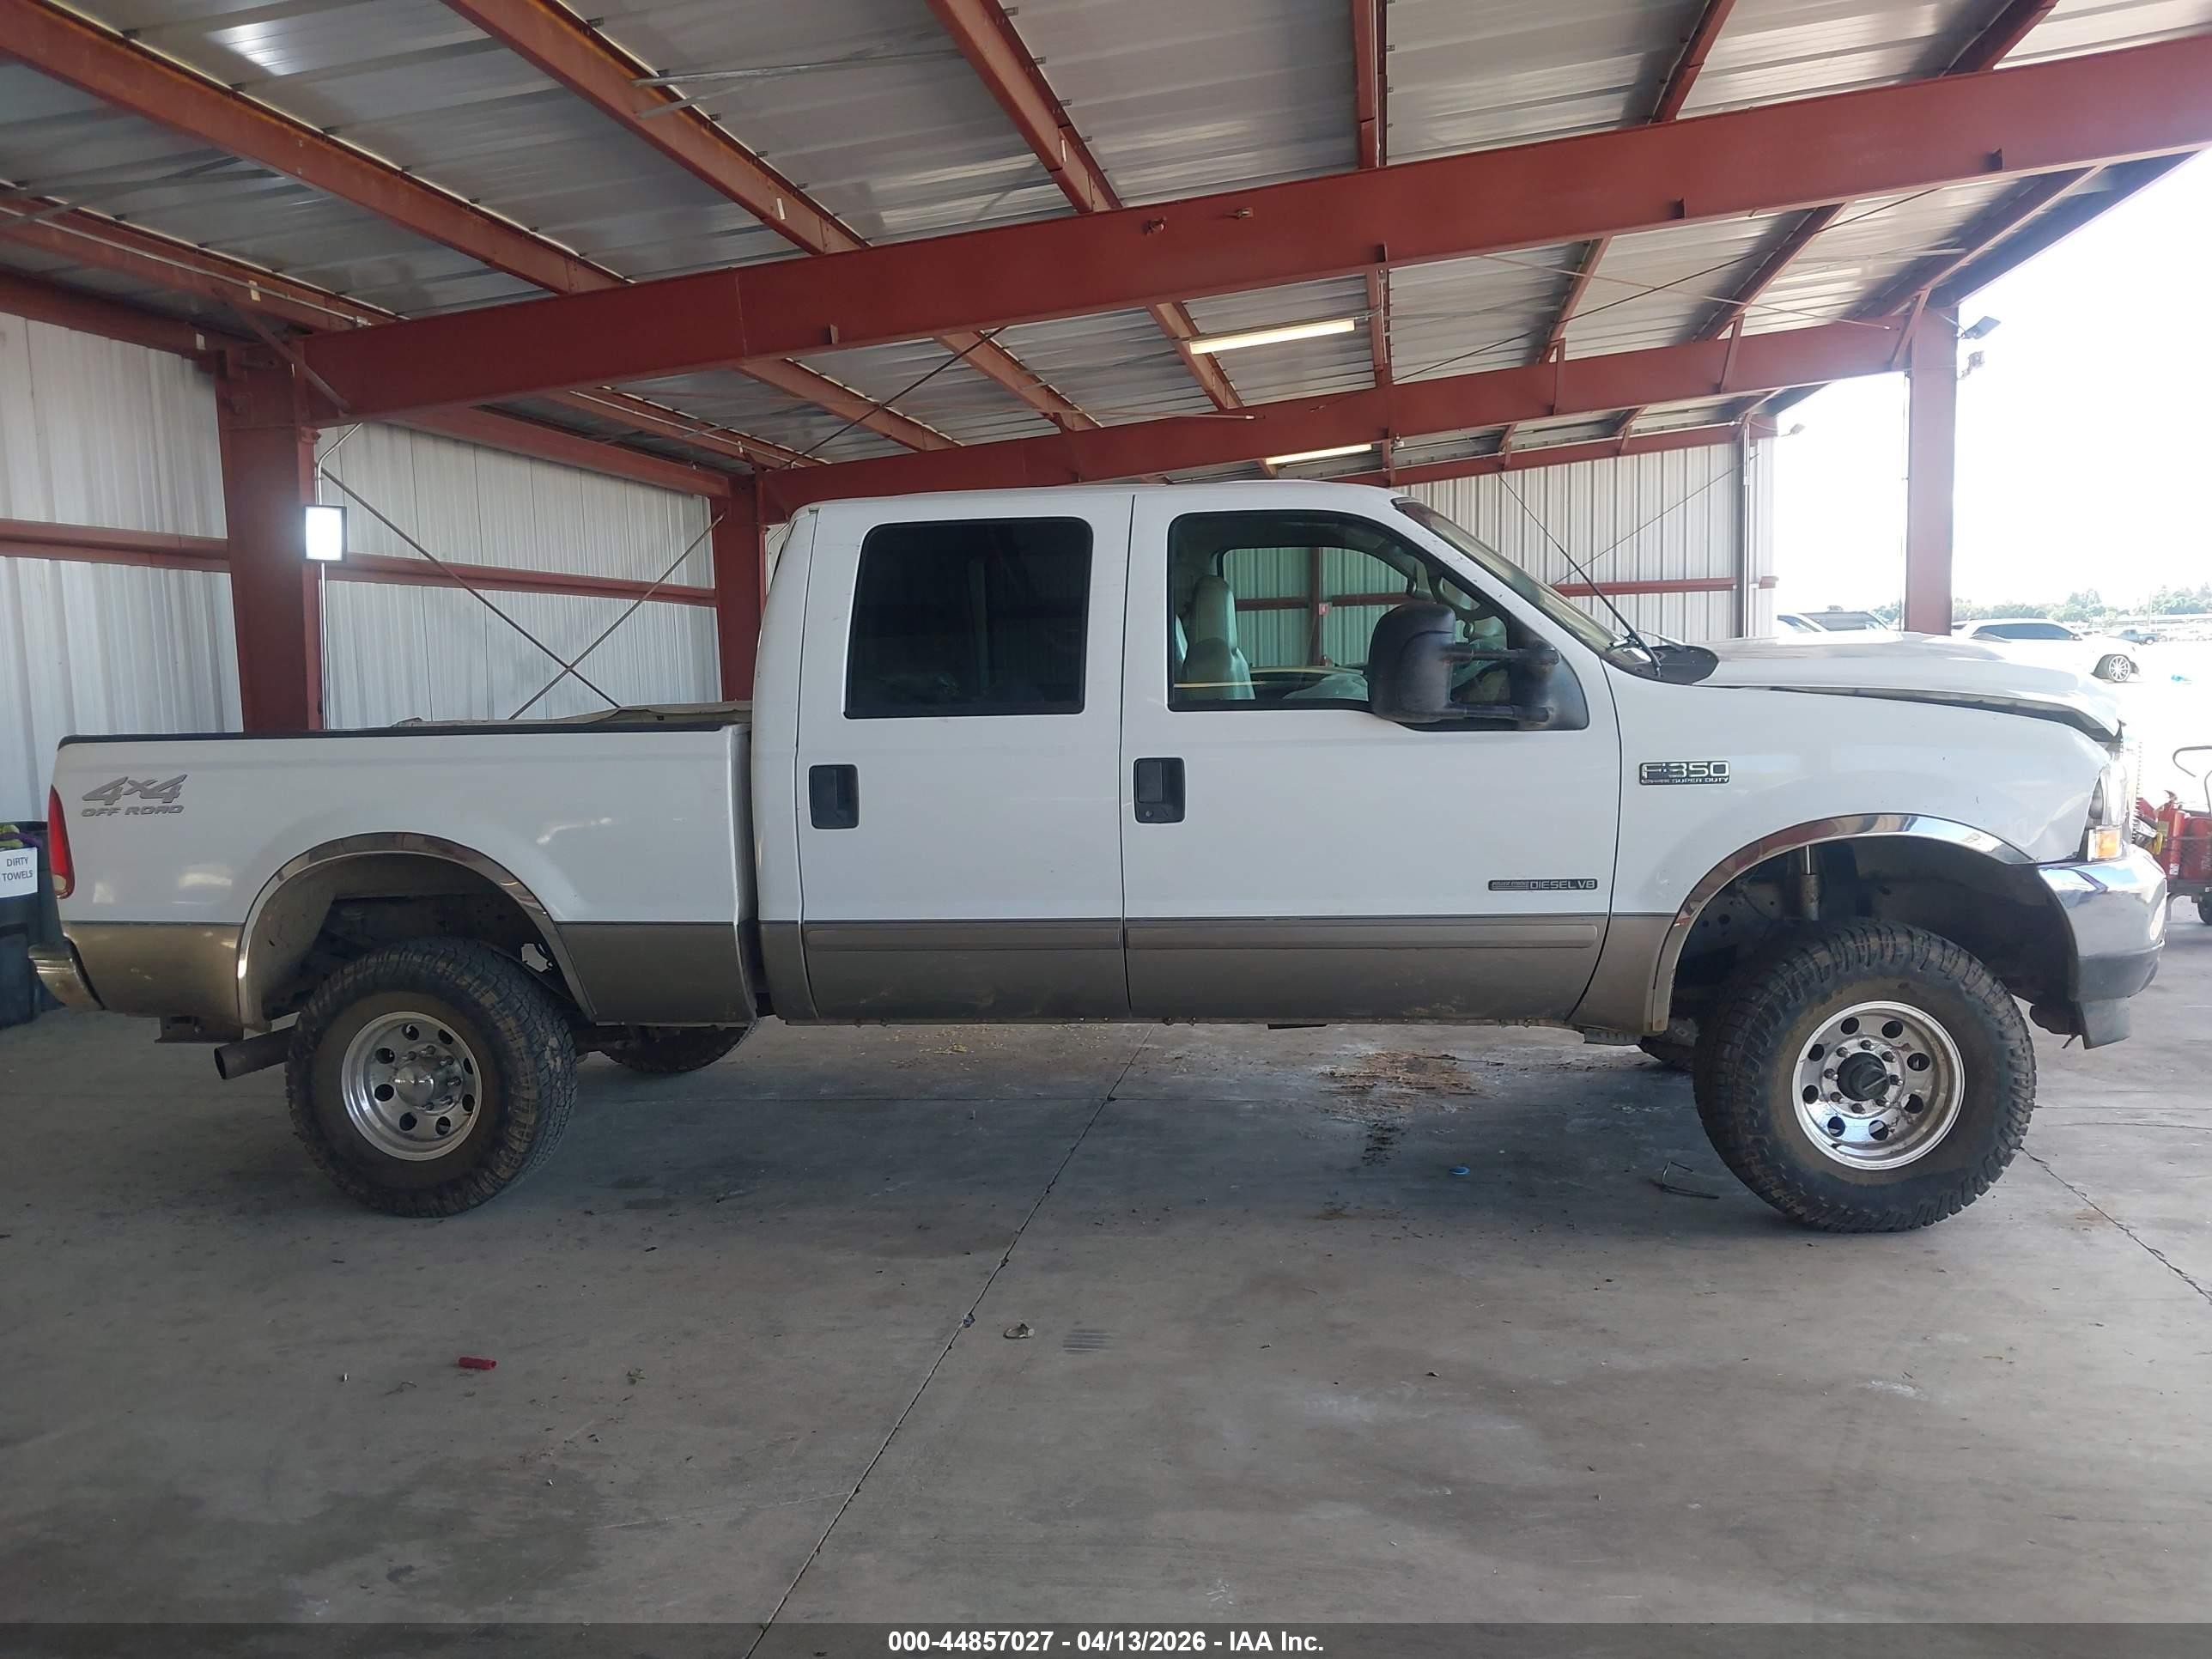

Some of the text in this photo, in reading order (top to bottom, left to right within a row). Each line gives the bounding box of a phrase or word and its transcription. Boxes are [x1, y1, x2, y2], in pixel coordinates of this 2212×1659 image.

[81, 805, 184, 817] OFF ROAD
[6, 856, 28, 867] DIRTY
[2, 869, 33, 882] TOWELS
[1529, 880, 1577, 890] DIESEL
[1577, 879, 1595, 889] V8
